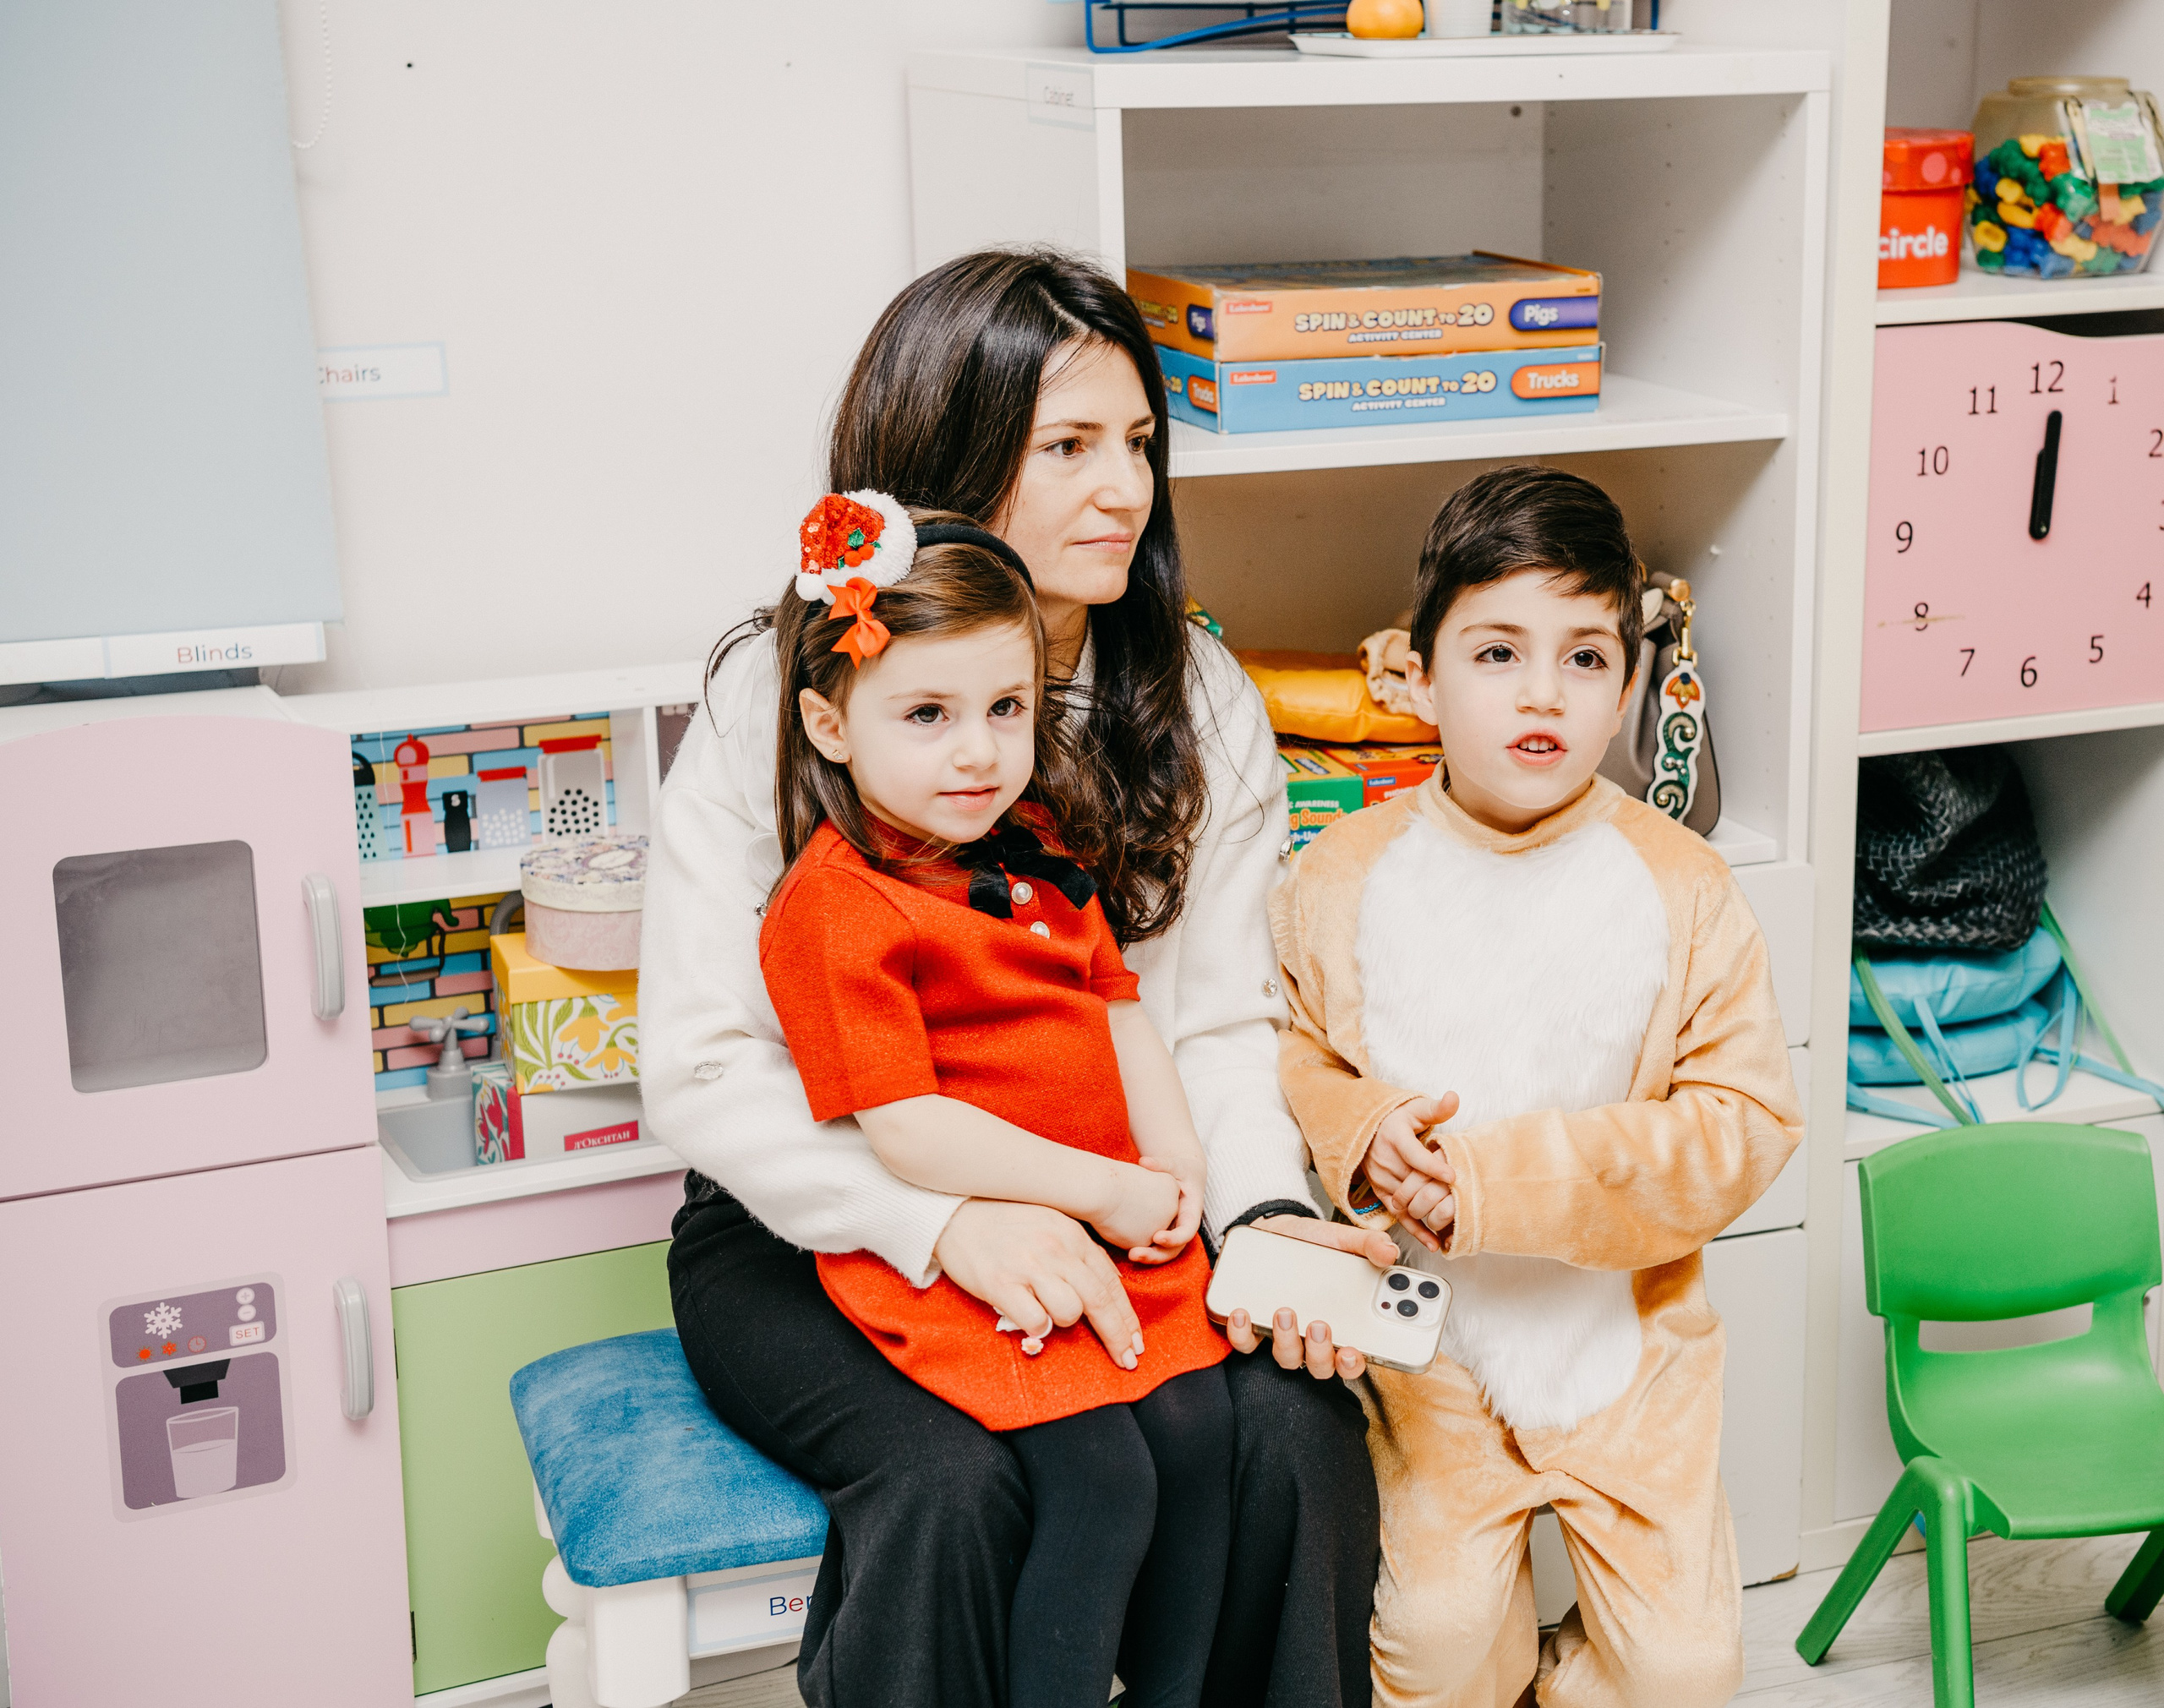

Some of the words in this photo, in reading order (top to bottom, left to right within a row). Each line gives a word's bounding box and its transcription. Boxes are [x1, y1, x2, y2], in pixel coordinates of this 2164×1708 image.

[1878, 225, 1949, 259] circle
[1295, 312, 1347, 332] SPIN
[1348, 314, 1360, 329] &
[1363, 308, 1437, 329] COUNT
[1439, 313, 1456, 325] TO
[1458, 303, 1495, 327] 20
[1524, 304, 1559, 326] Pigs
[1348, 332, 1398, 343] ACTIVITY
[1401, 329, 1442, 340] CENTER
[1298, 381, 1350, 401] SPIN
[1352, 382, 1363, 397] &
[1366, 376, 1440, 397] COUNT
[1442, 381, 1460, 393] TO
[1461, 369, 1497, 394] 20
[1527, 369, 1579, 390] Trucks
[2030, 360, 2064, 395] 12
[2108, 376, 2119, 405] 1
[1352, 400, 1402, 412] ACTIVITY
[1404, 397, 1446, 408] CENTER
[1968, 385, 1998, 416] 11
[2149, 428, 2164, 458] 2
[1917, 445, 1949, 477] 10
[1896, 521, 1914, 554] 9
[2136, 581, 2151, 609] 4
[1915, 603, 1929, 631] 8
[178, 643, 253, 663] Blinds
[1960, 647, 1975, 677] 7
[2089, 635, 2105, 663] 5
[2020, 656, 2038, 688] 6
[1295, 800, 1339, 809] AWARENESS
[1301, 809, 1347, 826] Sound
[236, 1327, 260, 1340] SET
